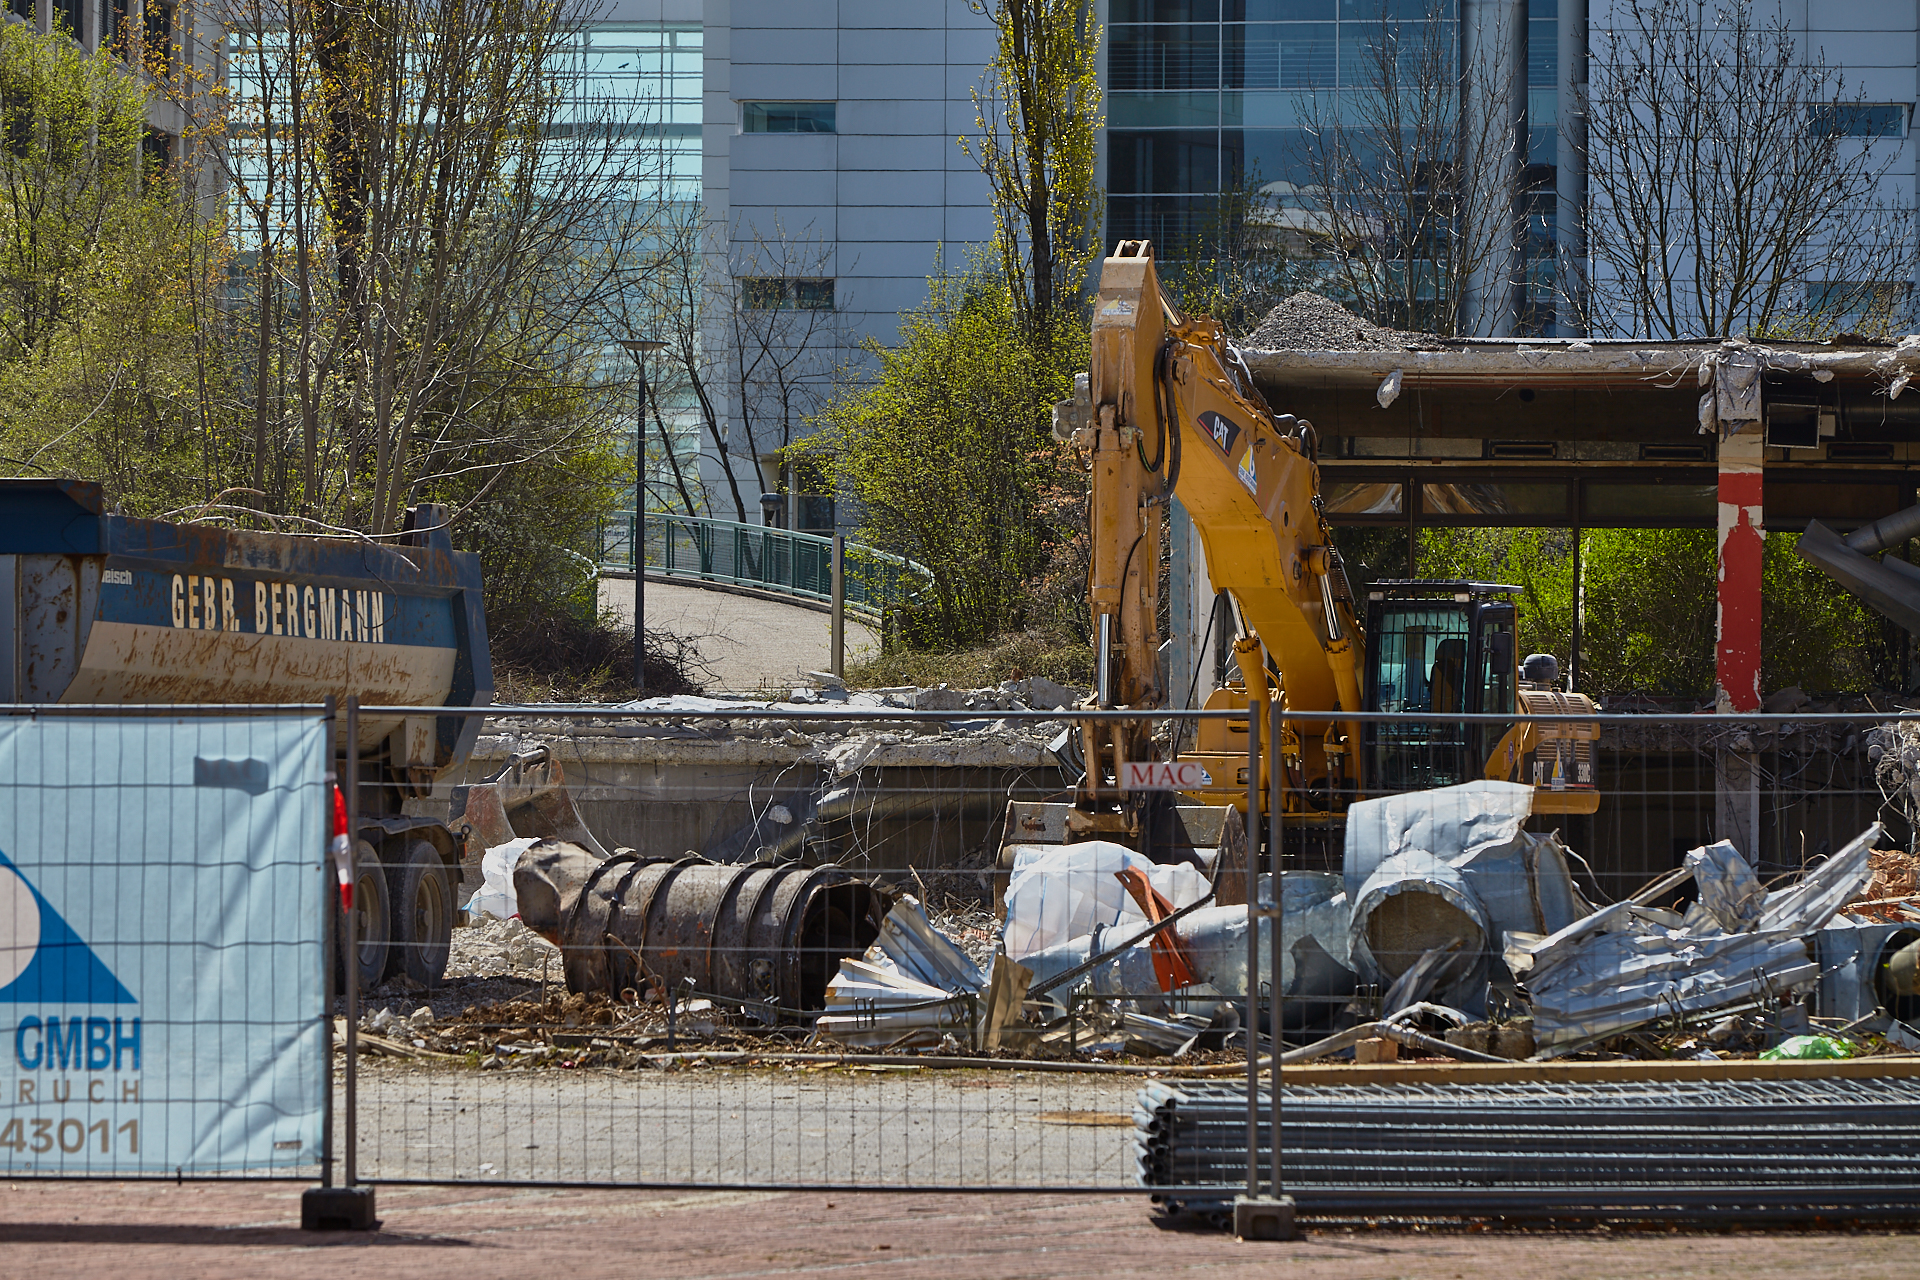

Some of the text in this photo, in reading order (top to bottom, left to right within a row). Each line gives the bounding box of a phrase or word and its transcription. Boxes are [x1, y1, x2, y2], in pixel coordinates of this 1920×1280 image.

[1213, 415, 1229, 451] CAT
[171, 573, 384, 643] GEBR. BERGMANN
[1129, 763, 1197, 786] MAC
[1532, 761, 1545, 787] CAT
[1577, 763, 1591, 783] 330C
[15, 1014, 141, 1071] GMBH
[0, 1079, 140, 1104] RUCH
[0, 1117, 139, 1154] 43011
